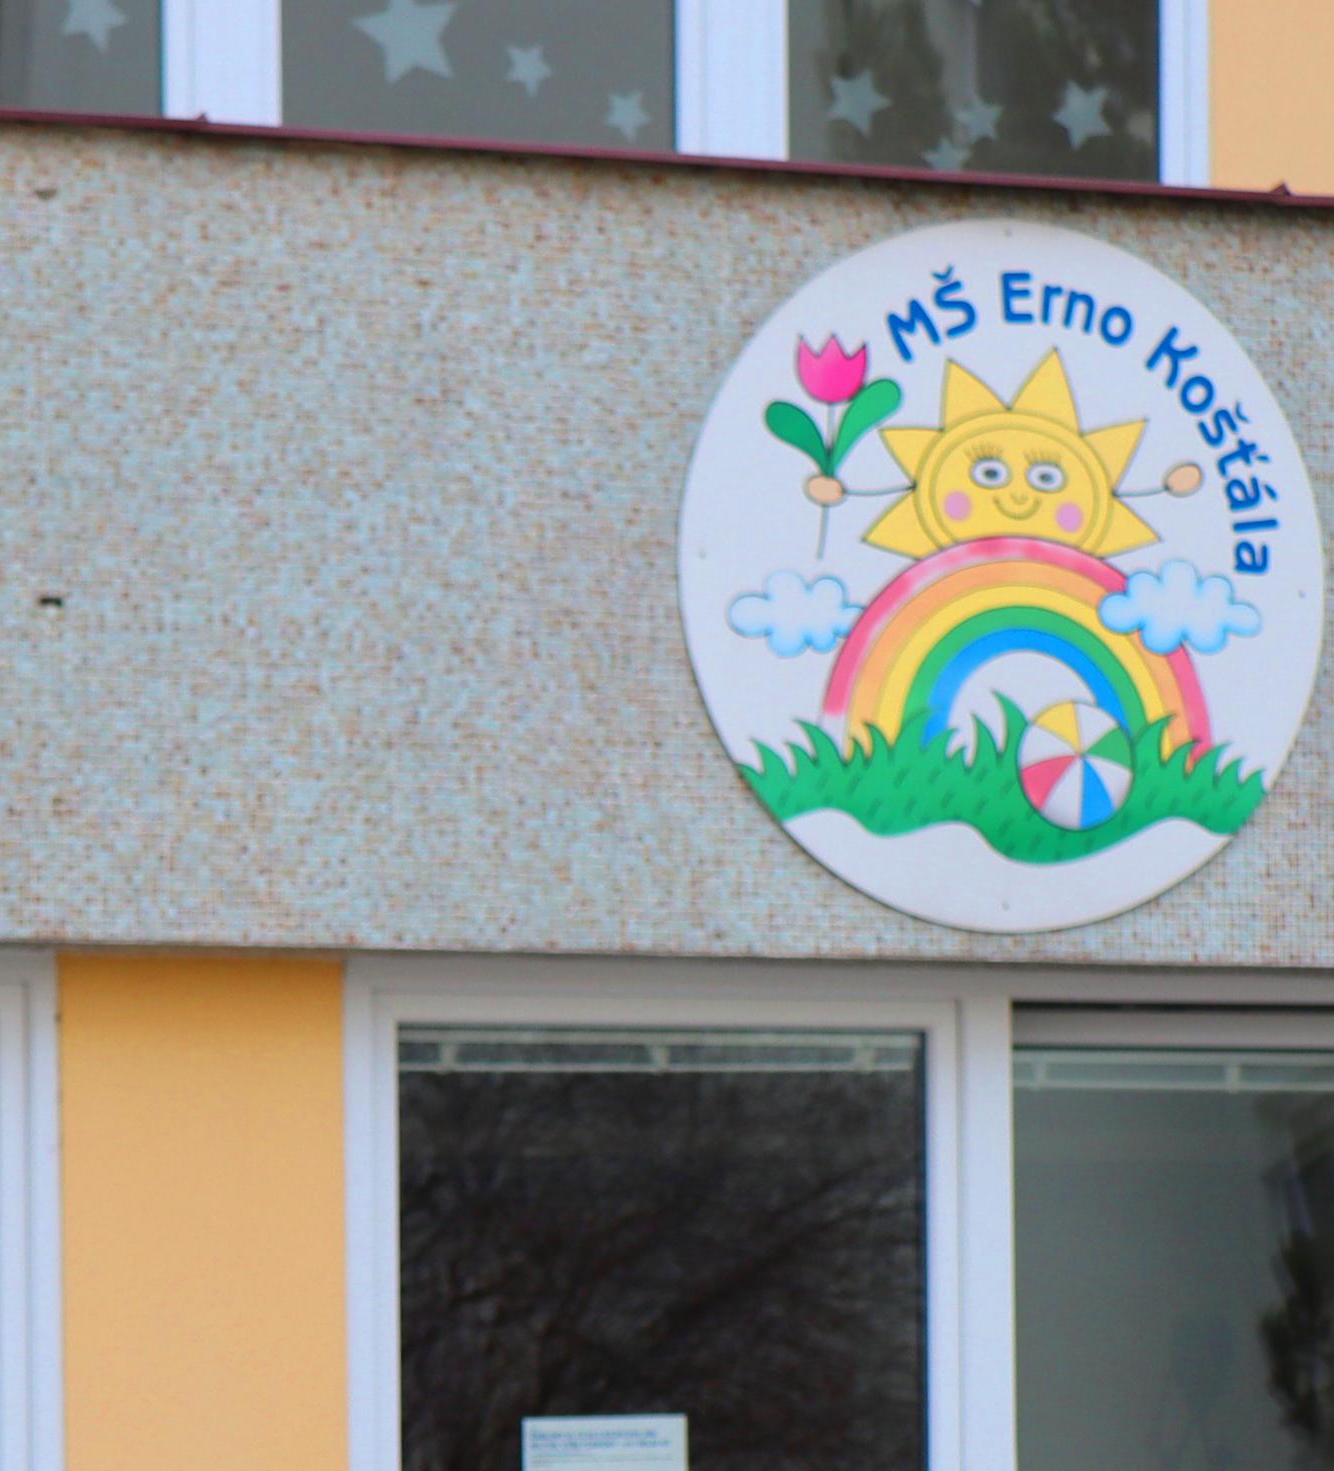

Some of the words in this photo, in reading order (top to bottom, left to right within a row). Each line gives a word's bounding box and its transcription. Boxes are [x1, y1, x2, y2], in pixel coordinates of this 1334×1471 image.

[885, 264, 980, 364] MŠ
[1000, 269, 1137, 348] Erno
[1144, 324, 1283, 578] Košťála
